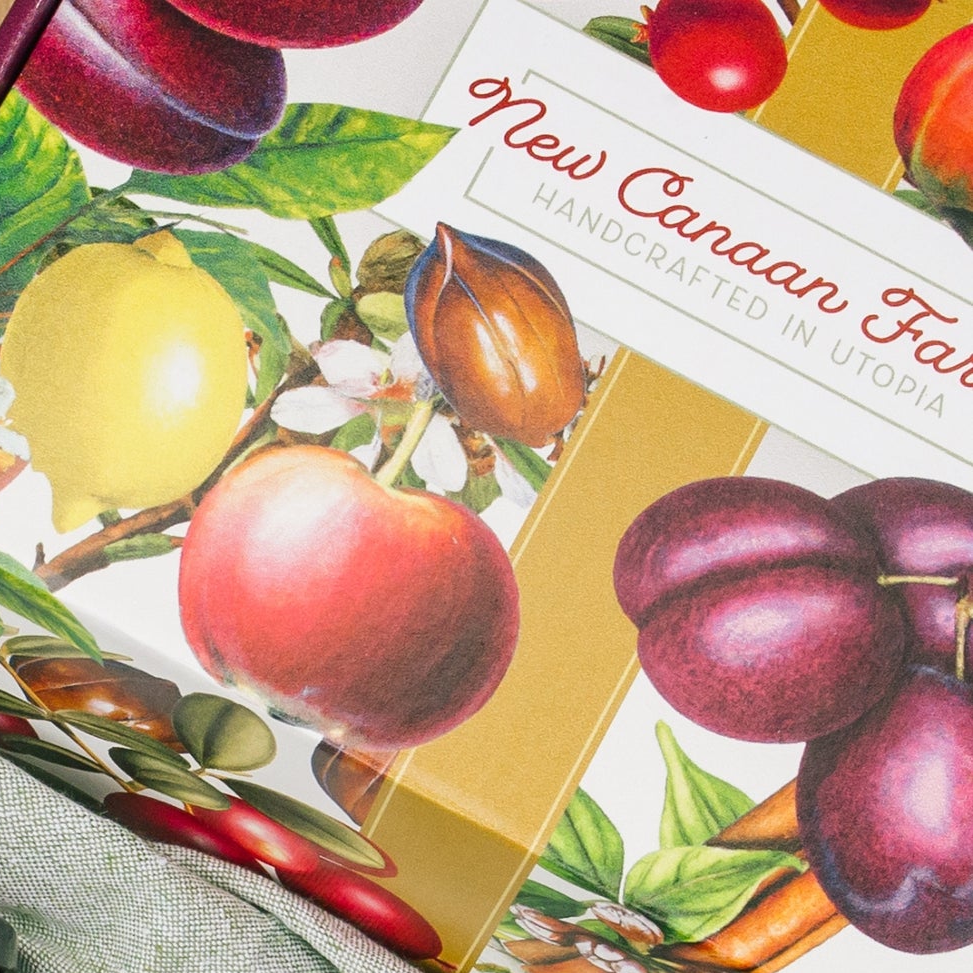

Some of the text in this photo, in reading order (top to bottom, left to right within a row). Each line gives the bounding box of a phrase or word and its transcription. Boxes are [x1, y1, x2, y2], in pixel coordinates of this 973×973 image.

[468, 76, 607, 181] New
[617, 167, 849, 314] Canaan
[532, 182, 944, 419] HANDCRAFTED IN UTOPIA
